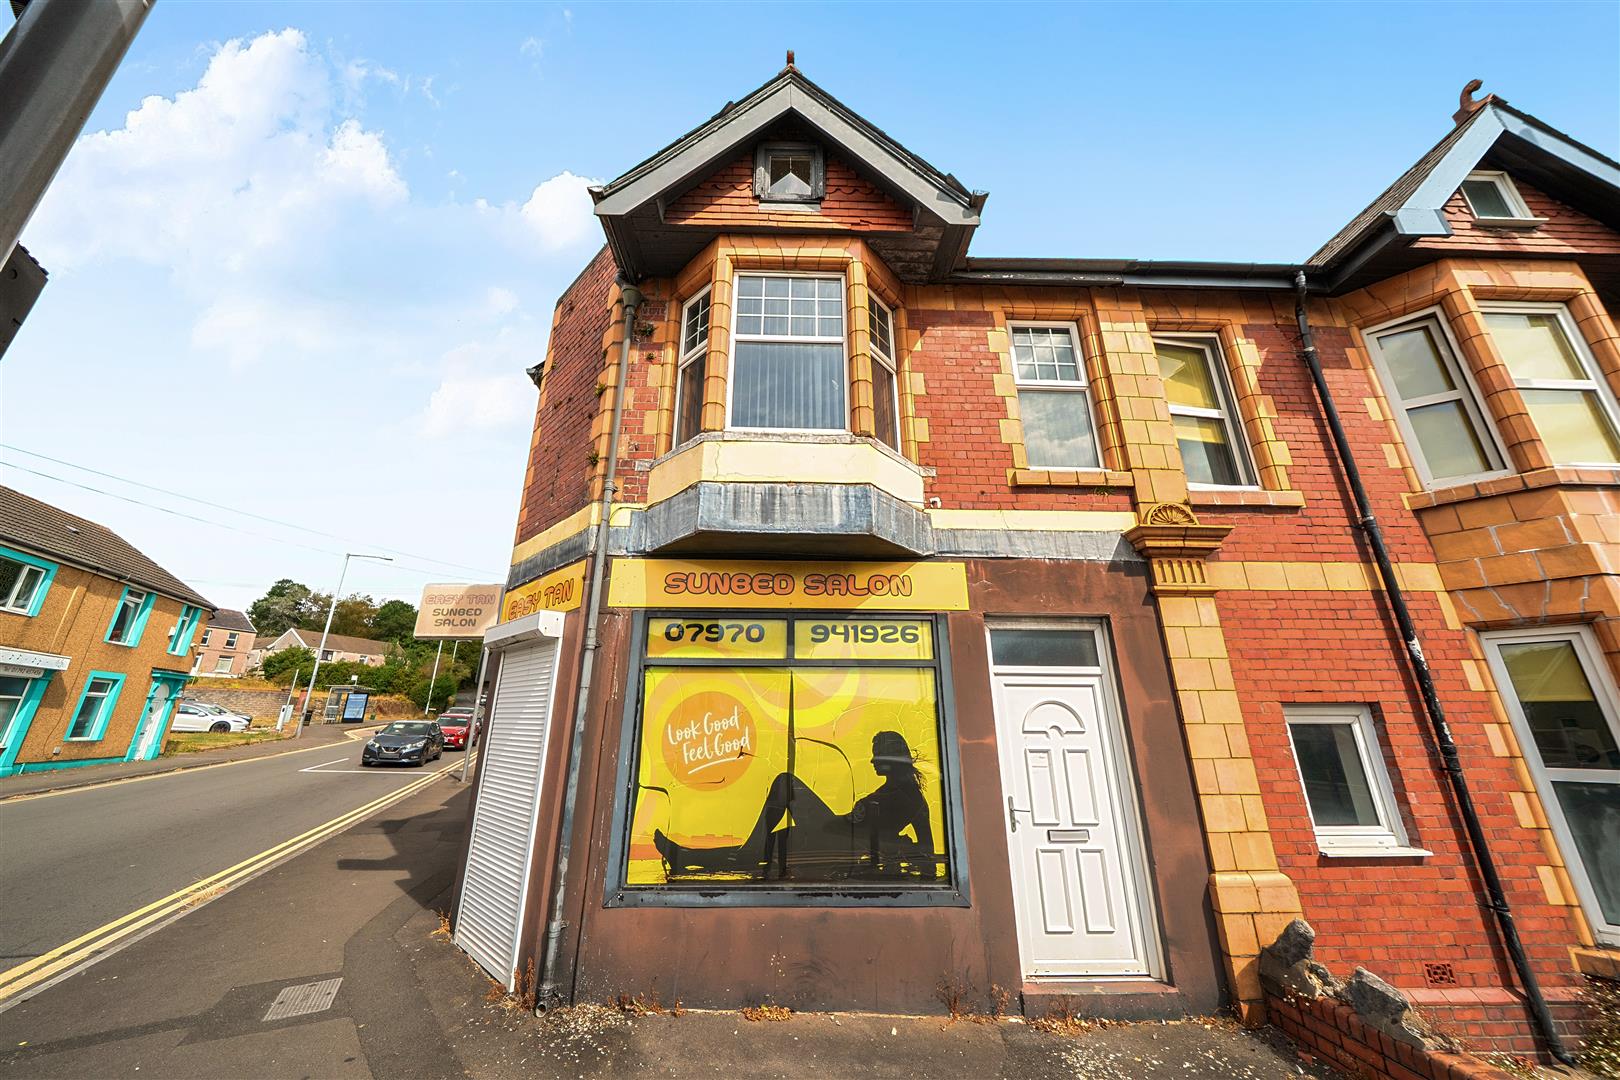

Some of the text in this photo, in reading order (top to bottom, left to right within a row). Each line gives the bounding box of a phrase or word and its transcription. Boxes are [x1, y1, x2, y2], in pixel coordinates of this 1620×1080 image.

[664, 572, 913, 597] SUNBED SALON
[425, 594, 496, 605] EASY TAN
[508, 577, 575, 621] EASY TAN
[432, 608, 483, 617] SUNBED
[434, 618, 477, 627] SALON
[664, 623, 920, 644] 07970 941926
[667, 704, 740, 745] Look Good
[682, 725, 751, 765] Feel Good
